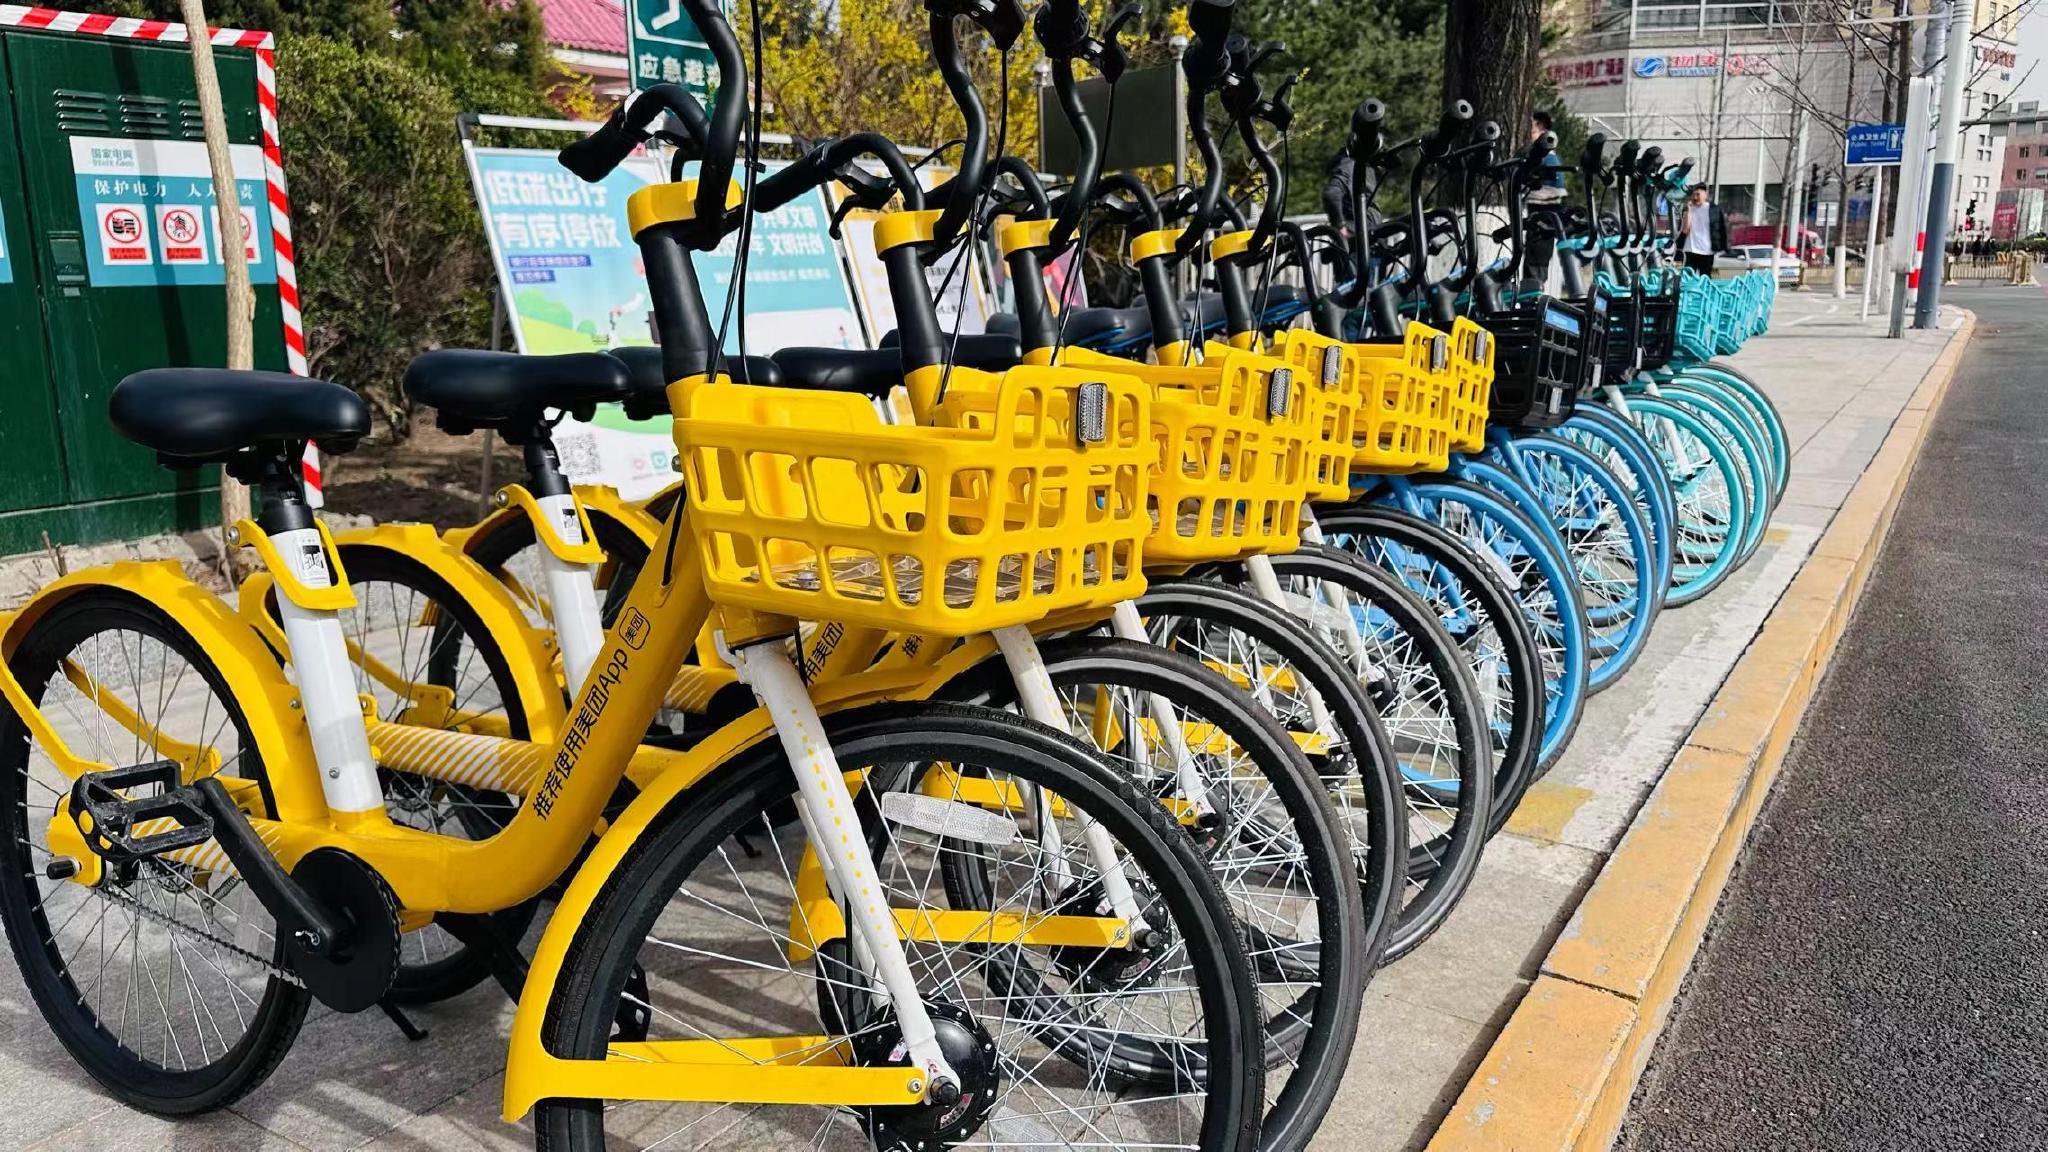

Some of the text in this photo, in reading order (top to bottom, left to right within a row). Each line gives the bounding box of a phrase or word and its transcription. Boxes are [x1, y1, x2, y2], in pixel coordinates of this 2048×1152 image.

[94, 179, 253, 200] 保护电力 人人责
[484, 170, 608, 208] 低碳出行
[494, 212, 623, 249] 有序停放
[624, 612, 644, 645] 美团
[803, 622, 845, 688] 用美团
[533, 648, 629, 821] 推荐使用美团App
